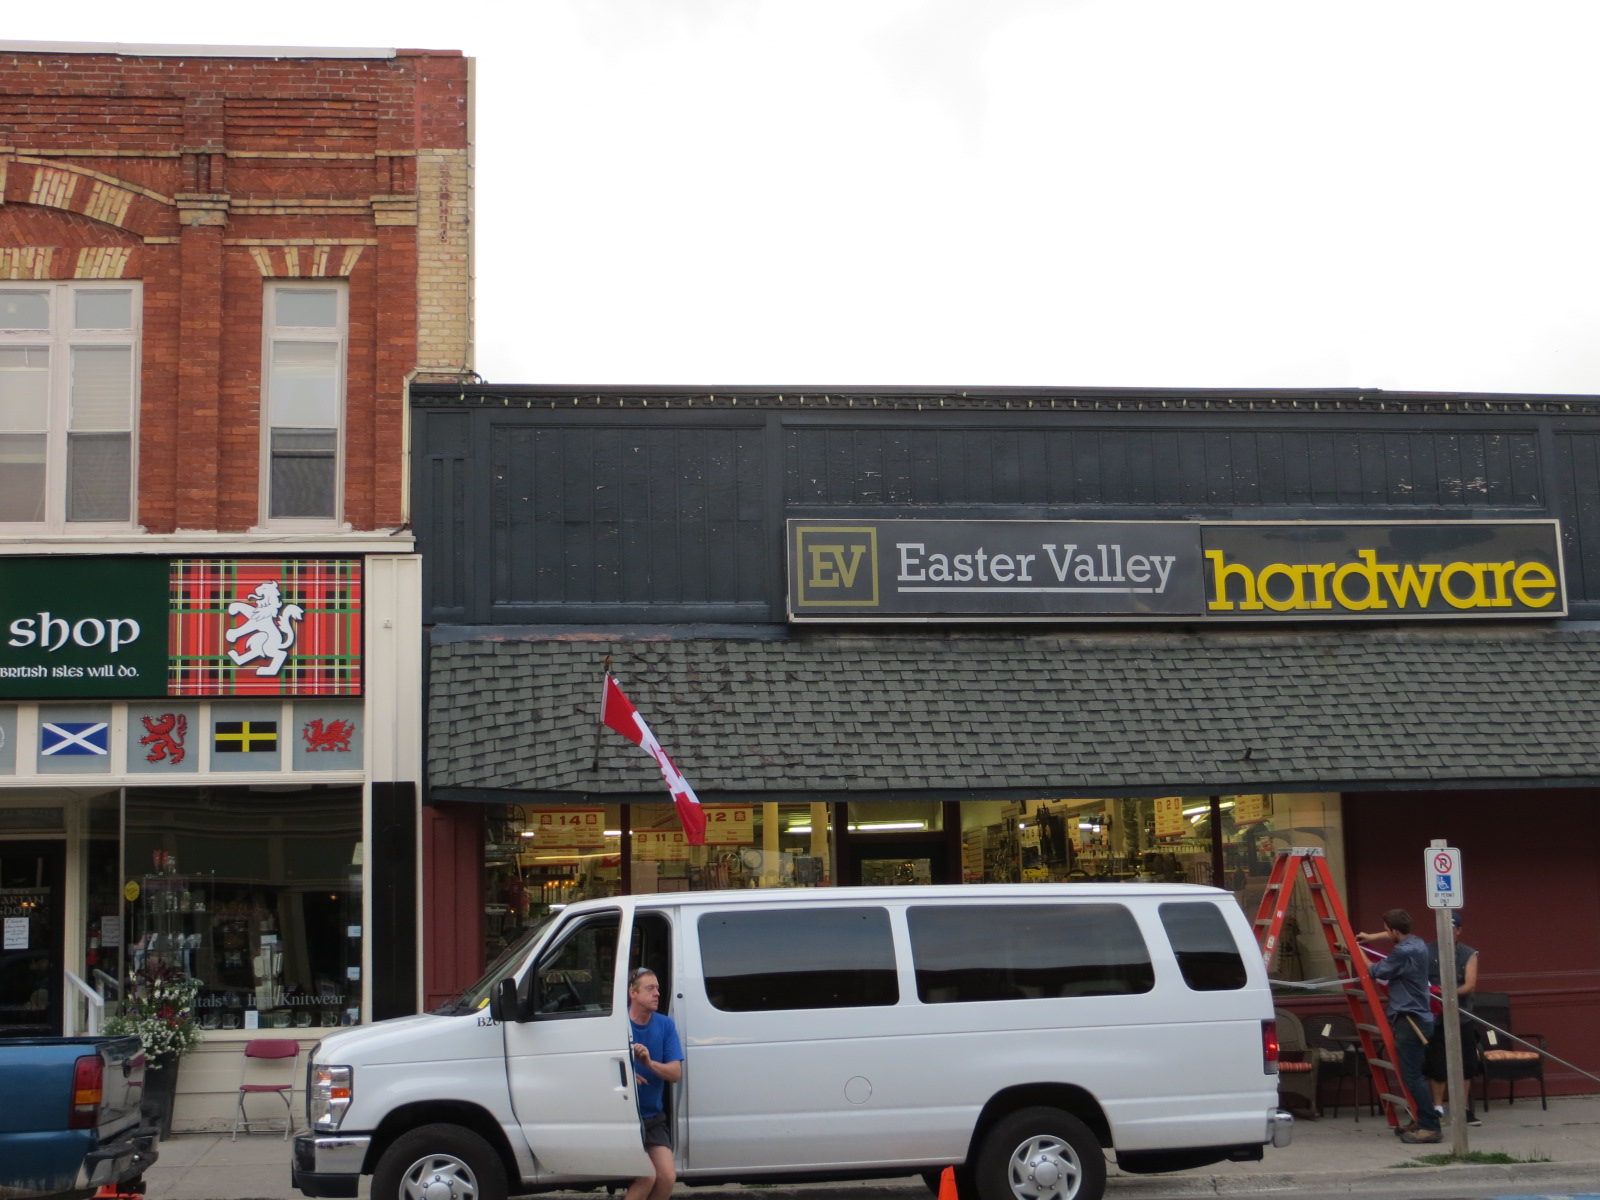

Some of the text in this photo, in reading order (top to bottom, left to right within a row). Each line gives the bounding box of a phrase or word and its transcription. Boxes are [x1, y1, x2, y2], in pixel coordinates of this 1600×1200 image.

[808, 545, 866, 588] EV
[896, 543, 1176, 593] Easter Valley
[1205, 549, 1556, 611] hardware
[8, 611, 140, 653] shop
[559, 815, 581, 825] 14
[706, 812, 727, 822] 12
[655, 834, 666, 842] 11
[281, 992, 345, 1006] Knitwear
